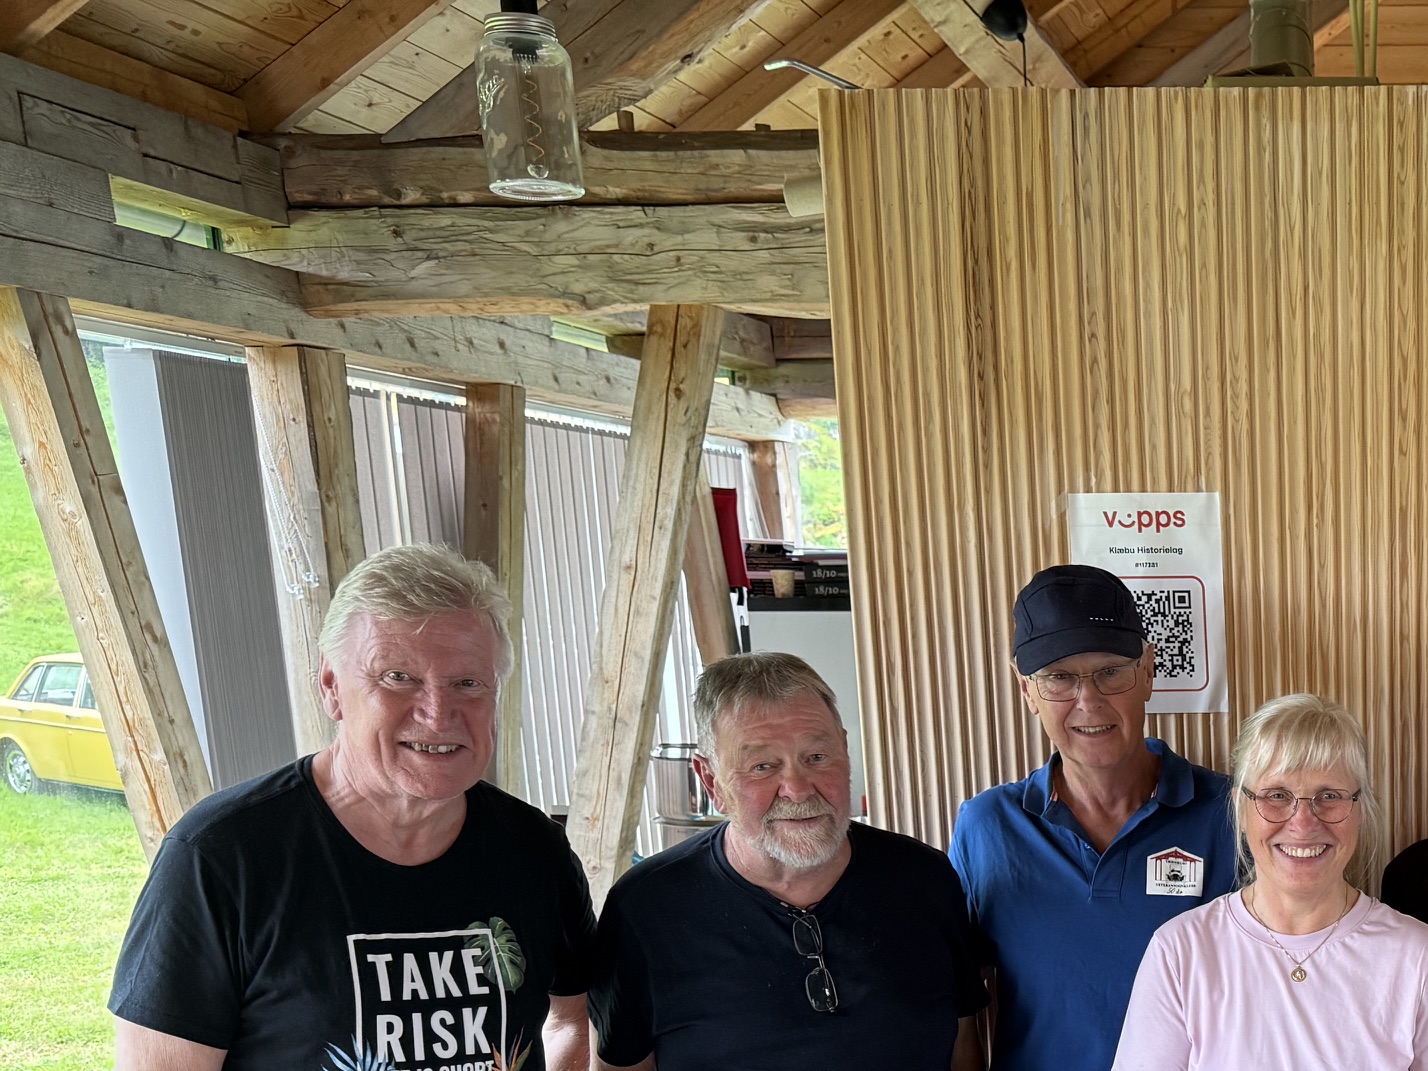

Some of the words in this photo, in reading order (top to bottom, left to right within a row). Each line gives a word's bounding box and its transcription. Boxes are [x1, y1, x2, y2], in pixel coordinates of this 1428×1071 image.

[1109, 546, 1135, 554] Klæbu
[1137, 546, 1183, 555] Historielag
[812, 568, 837, 579] 18/10
[815, 585, 839, 596] 18/10
[367, 948, 490, 1002] TAKE
[376, 1006, 492, 1063] RISK
